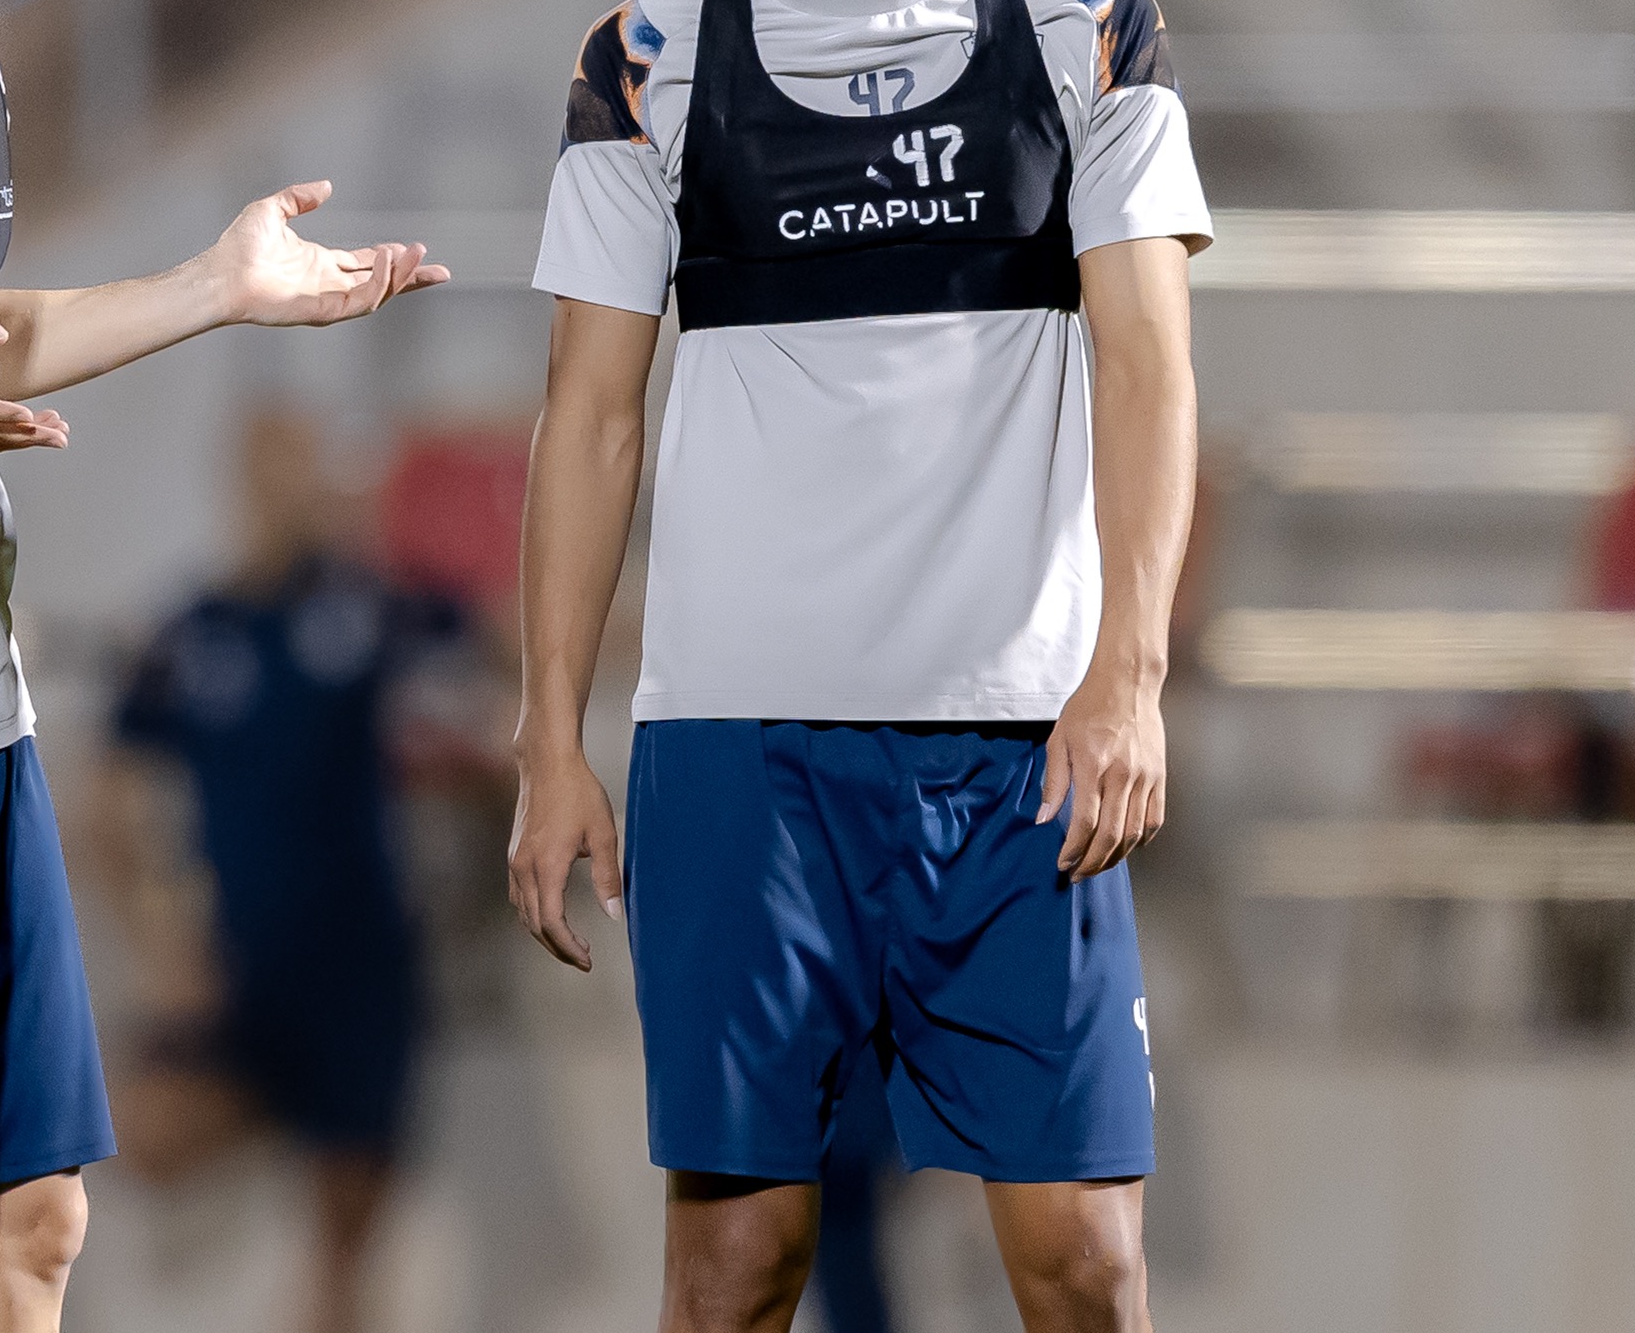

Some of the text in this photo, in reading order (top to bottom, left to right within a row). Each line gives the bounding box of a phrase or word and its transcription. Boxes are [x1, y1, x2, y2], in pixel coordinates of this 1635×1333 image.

[848, 68, 915, 116] 47
[892, 124, 964, 187] 47
[778, 191, 985, 240] CATAPULT
